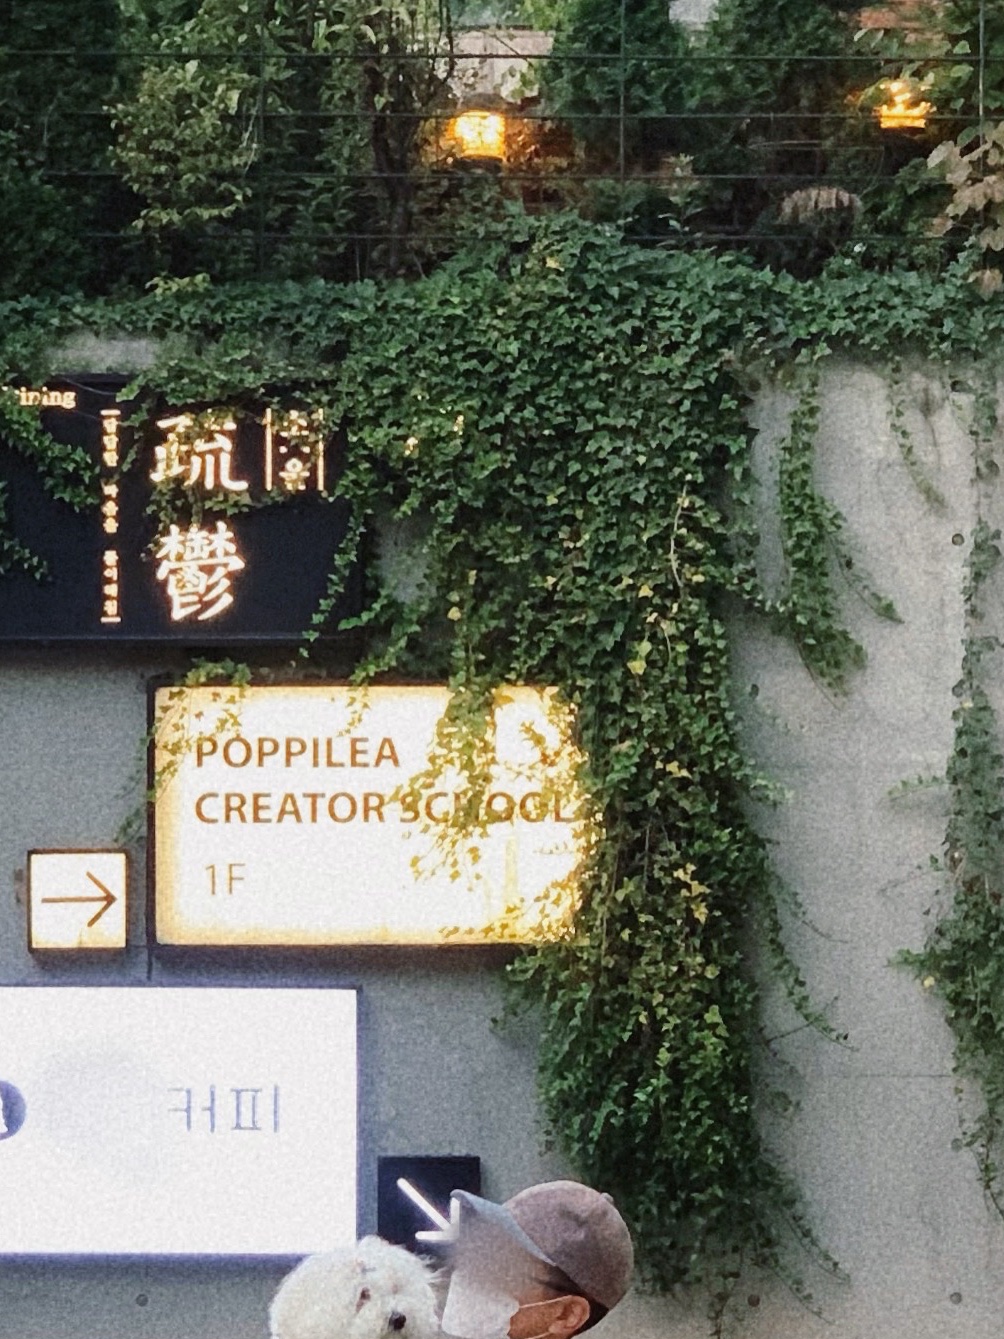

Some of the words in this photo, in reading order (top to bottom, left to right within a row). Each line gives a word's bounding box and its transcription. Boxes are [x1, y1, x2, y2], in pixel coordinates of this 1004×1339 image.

[1, 385, 76, 410] ining
[196, 735, 400, 768] POPPILEA
[194, 791, 385, 824] CREATOR
[205, 863, 246, 896] 1F
[167, 1084, 281, 1134] 커피
